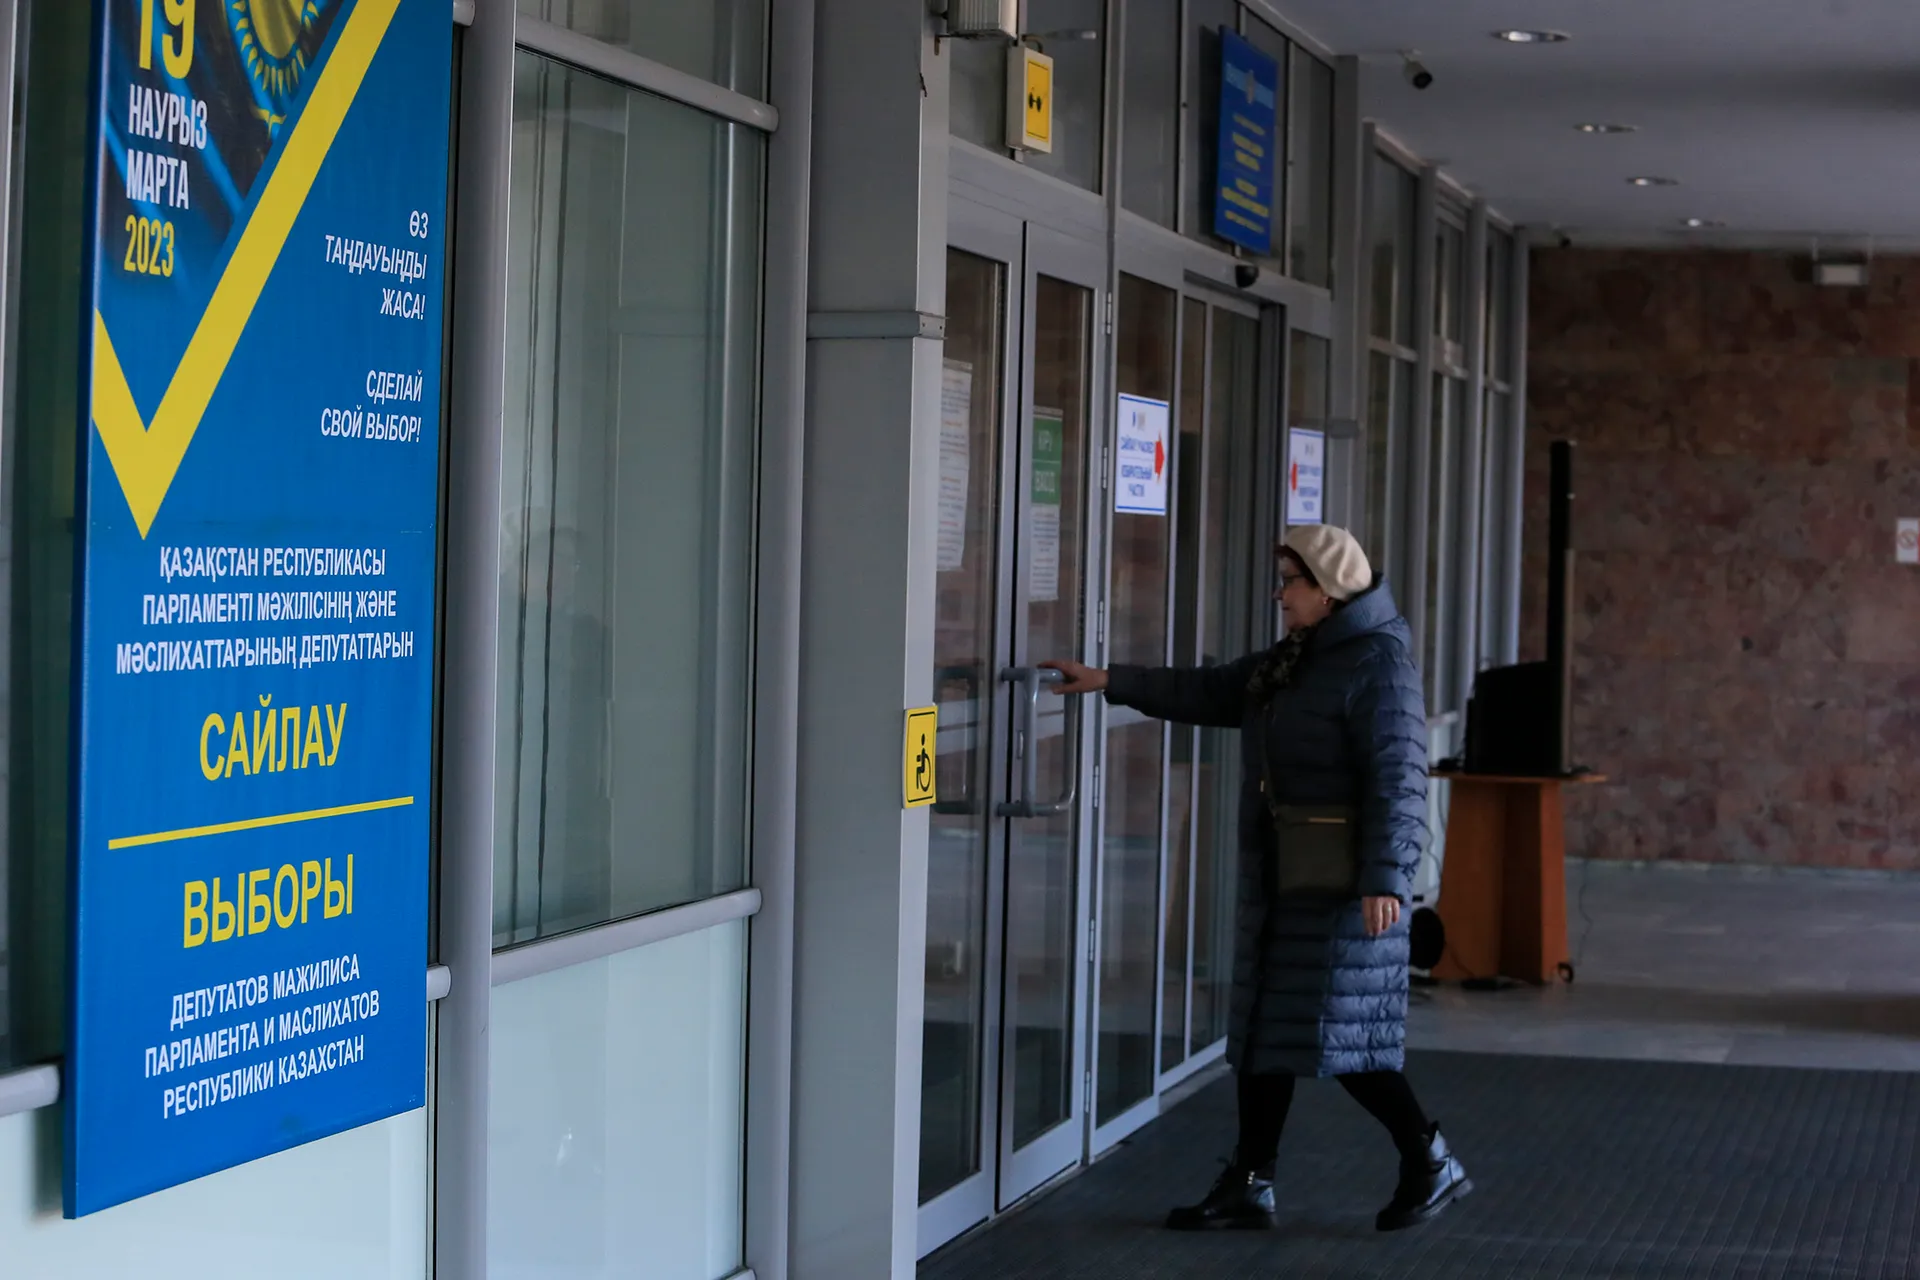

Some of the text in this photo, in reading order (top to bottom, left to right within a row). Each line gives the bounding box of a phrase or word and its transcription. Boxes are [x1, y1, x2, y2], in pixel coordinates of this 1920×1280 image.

[138, 0, 196, 79] 19
[127, 83, 208, 150] НАУРЫЗ
[126, 148, 189, 209] МАРТА
[123, 214, 175, 277] 2023
[409, 210, 429, 239] ӨЗ
[325, 234, 428, 283] ТАҢДАУЫҢДЫ
[380, 287, 425, 320] ЖАСА!
[366, 370, 422, 403] СДЕЛАЙ
[321, 404, 421, 443] СВОЙ ВЫБОР!
[160, 546, 386, 583] ҚАЗАҚСТАН РЕСПУБЛИКАСЫ
[143, 590, 397, 625] ПАРЛАМЕНТІ МӘЖІЛІСІНІҢ ЖӘНЕ
[116, 631, 414, 674] МӘСЛИХАТТАРЫНЫҢ ДЕПУТАТТАРЫН
[199, 695, 347, 780] САЙЛАУ
[183, 854, 353, 948] ВЫБОРЫ
[170, 953, 360, 1031] ДЕПУТАТОВ МАЖИЛИСА
[145, 989, 380, 1079] ПАРЛАМЕНТА И МАСЛИХАТОВ
[163, 1034, 365, 1119] РЕСПУБЛИКИ КАЗАХСТАН
